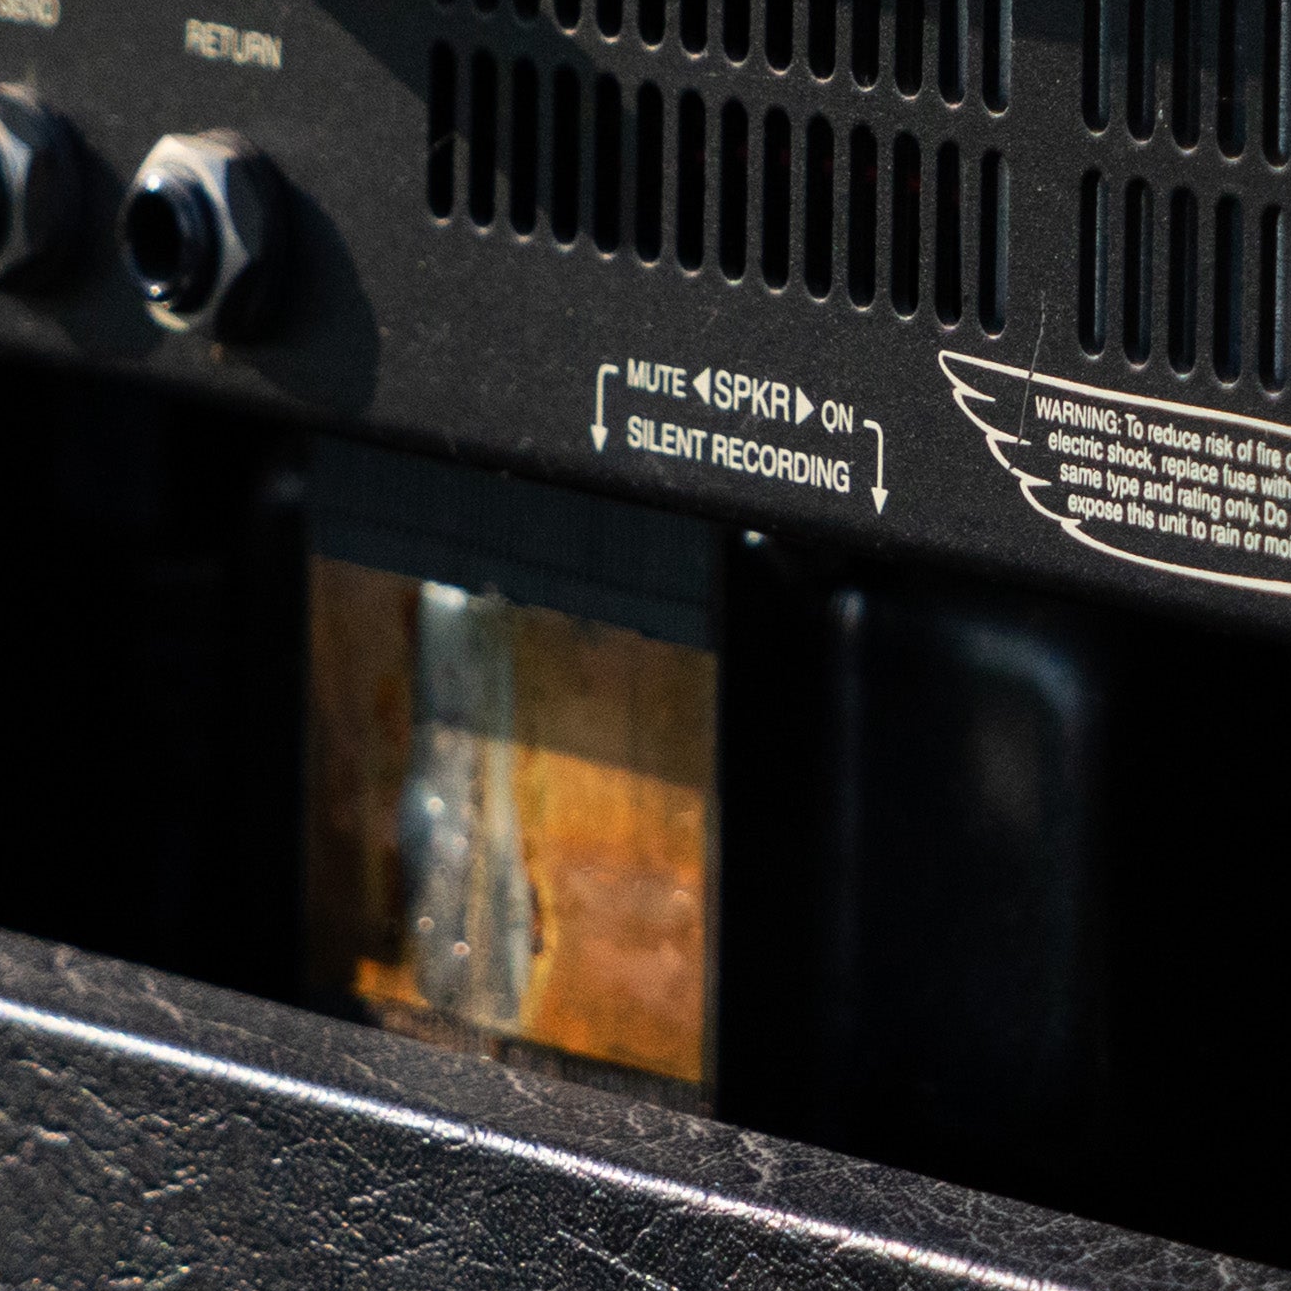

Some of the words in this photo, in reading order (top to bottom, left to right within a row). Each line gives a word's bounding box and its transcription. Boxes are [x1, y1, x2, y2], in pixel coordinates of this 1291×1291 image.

[184, 18, 283, 71] RETURN
[627, 358, 687, 398] MUTE
[713, 369, 790, 422] SPKR
[821, 400, 853, 434] ON
[627, 415, 707, 460] SILENT
[711, 434, 851, 494] RECORDING
[1035, 395, 1121, 436] WARNING:
[1124, 413, 1144, 440] To
[1148, 423, 1201, 452] reduce
[1205, 431, 1234, 459] risk
[1237, 439, 1253, 462] of
[1256, 441, 1282, 469] fire
[1048, 429, 1104, 461] electric
[1107, 441, 1156, 475] shock,
[1161, 455, 1219, 485] replace
[1223, 463, 1257, 493] fuse
[1060, 463, 1102, 489] same
[1106, 469, 1140, 499] type
[1143, 480, 1173, 504] and
[1177, 487, 1221, 520] rating
[1225, 497, 1260, 528] only.
[1264, 500, 1288, 529] Do
[1067, 494, 1123, 521] expose
[1127, 502, 1155, 529] this
[1158, 512, 1188, 537] unit
[1191, 516, 1207, 540] to
[1211, 522, 1240, 548] rain
[1244, 531, 1262, 552] or
